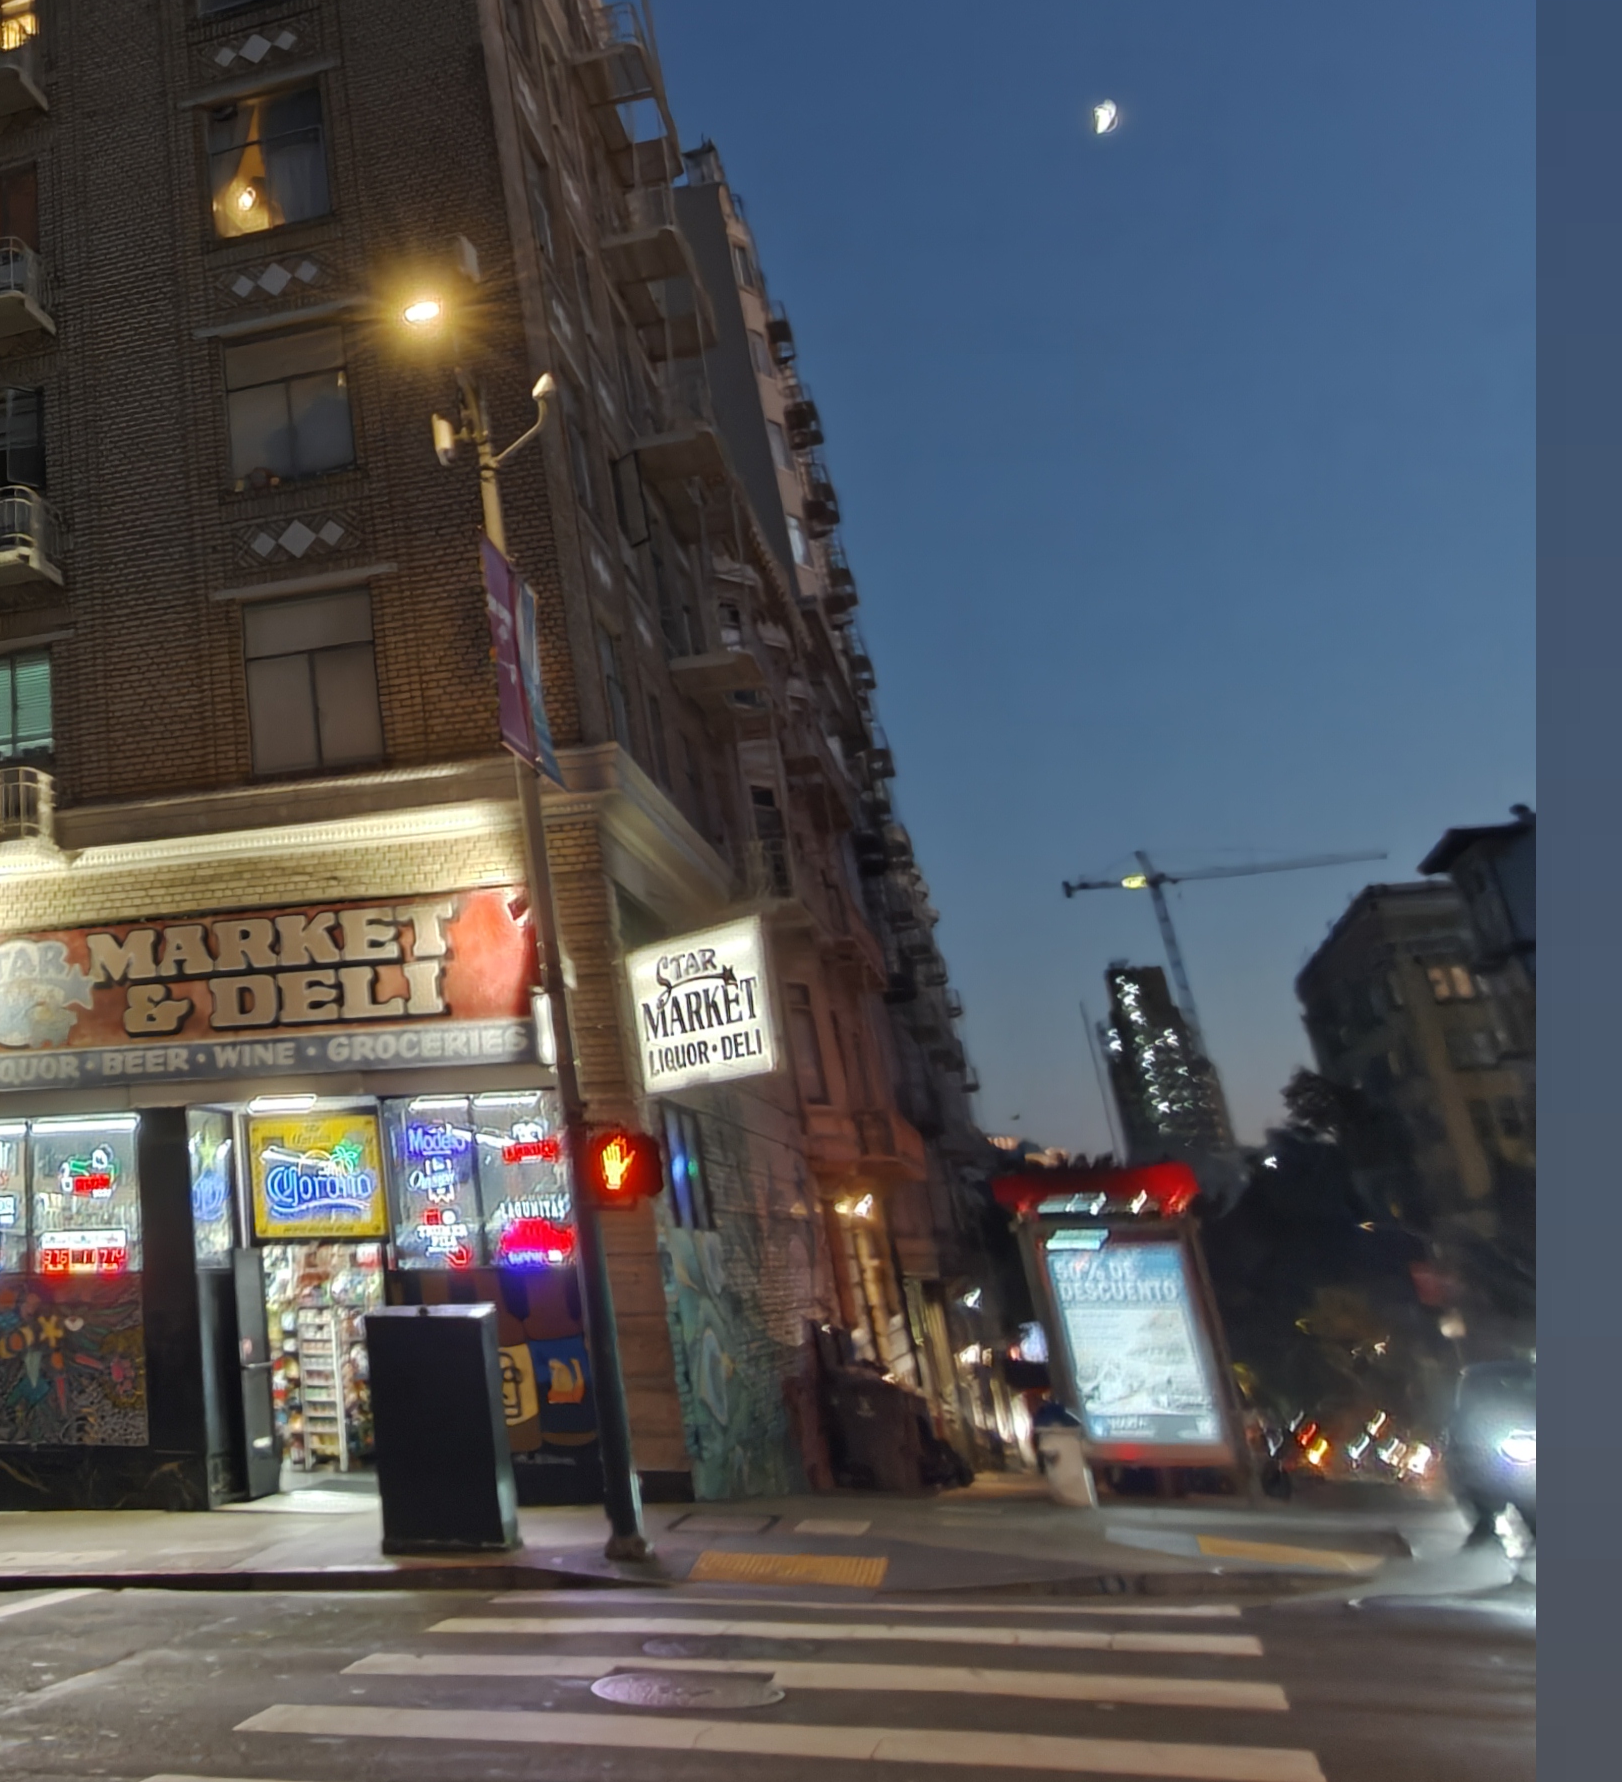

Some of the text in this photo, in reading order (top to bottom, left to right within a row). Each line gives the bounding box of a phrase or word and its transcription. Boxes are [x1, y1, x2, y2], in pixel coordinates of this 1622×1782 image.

[86, 901, 454, 984] MARKET
[123, 960, 446, 1034] & DELI
[657, 948, 718, 1007] STAR
[642, 976, 758, 1042] MARKET
[101, 1048, 190, 1077] BEER
[212, 1042, 296, 1069] WINE
[327, 1025, 528, 1062] GROCERIES
[649, 1028, 763, 1078] LIQUOR DELI
[267, 1165, 373, 1207] Corona
[1058, 1280, 1179, 1302] DESCUENTO
